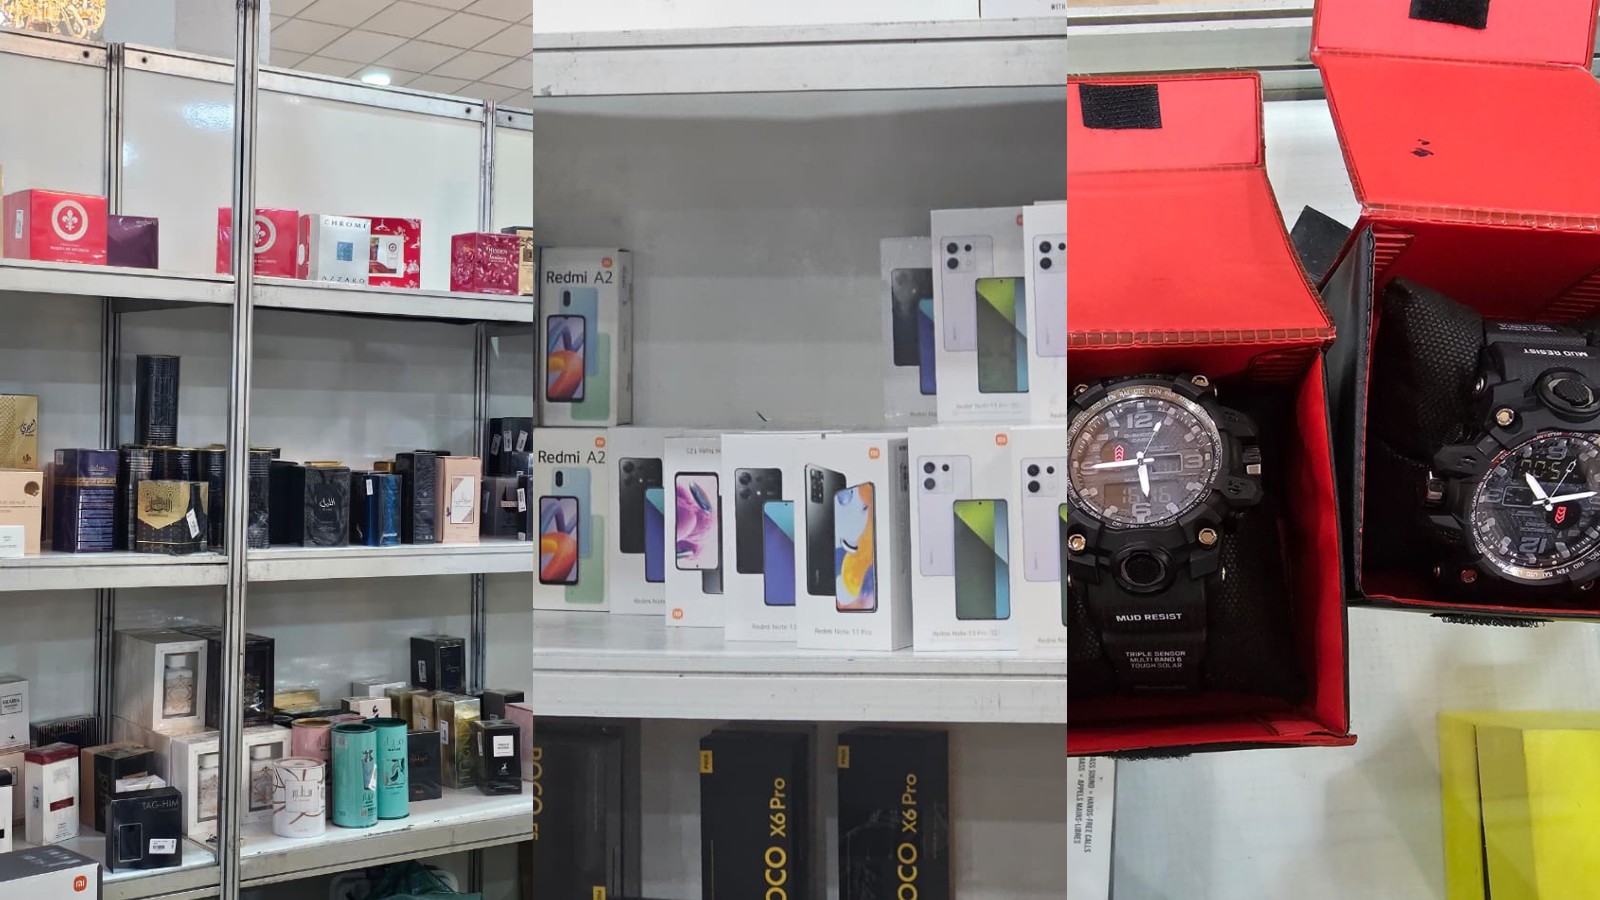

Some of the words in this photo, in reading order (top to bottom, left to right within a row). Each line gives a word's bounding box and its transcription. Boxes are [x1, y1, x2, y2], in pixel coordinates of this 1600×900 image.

[546, 270, 588, 284] Redmi
[593, 271, 613, 284] A2
[1523, 348, 1562, 356] RESIST
[1126, 412, 1154, 430] 12
[538, 450, 580, 464] Redmi
[587, 451, 606, 464] A2
[1115, 614, 1142, 622] MUD
[1144, 613, 1182, 621] RESIST
[901, 773, 918, 805] Pro
[1087, 770, 1096, 789] SOUND
[769, 777, 787, 809] Pro
[1076, 779, 1085, 801] APPELS
[142, 799, 179, 810] TAG-HIM
[769, 812, 787, 838] X6
[901, 808, 918, 834] X6
[1083, 834, 1092, 853] CALLS
